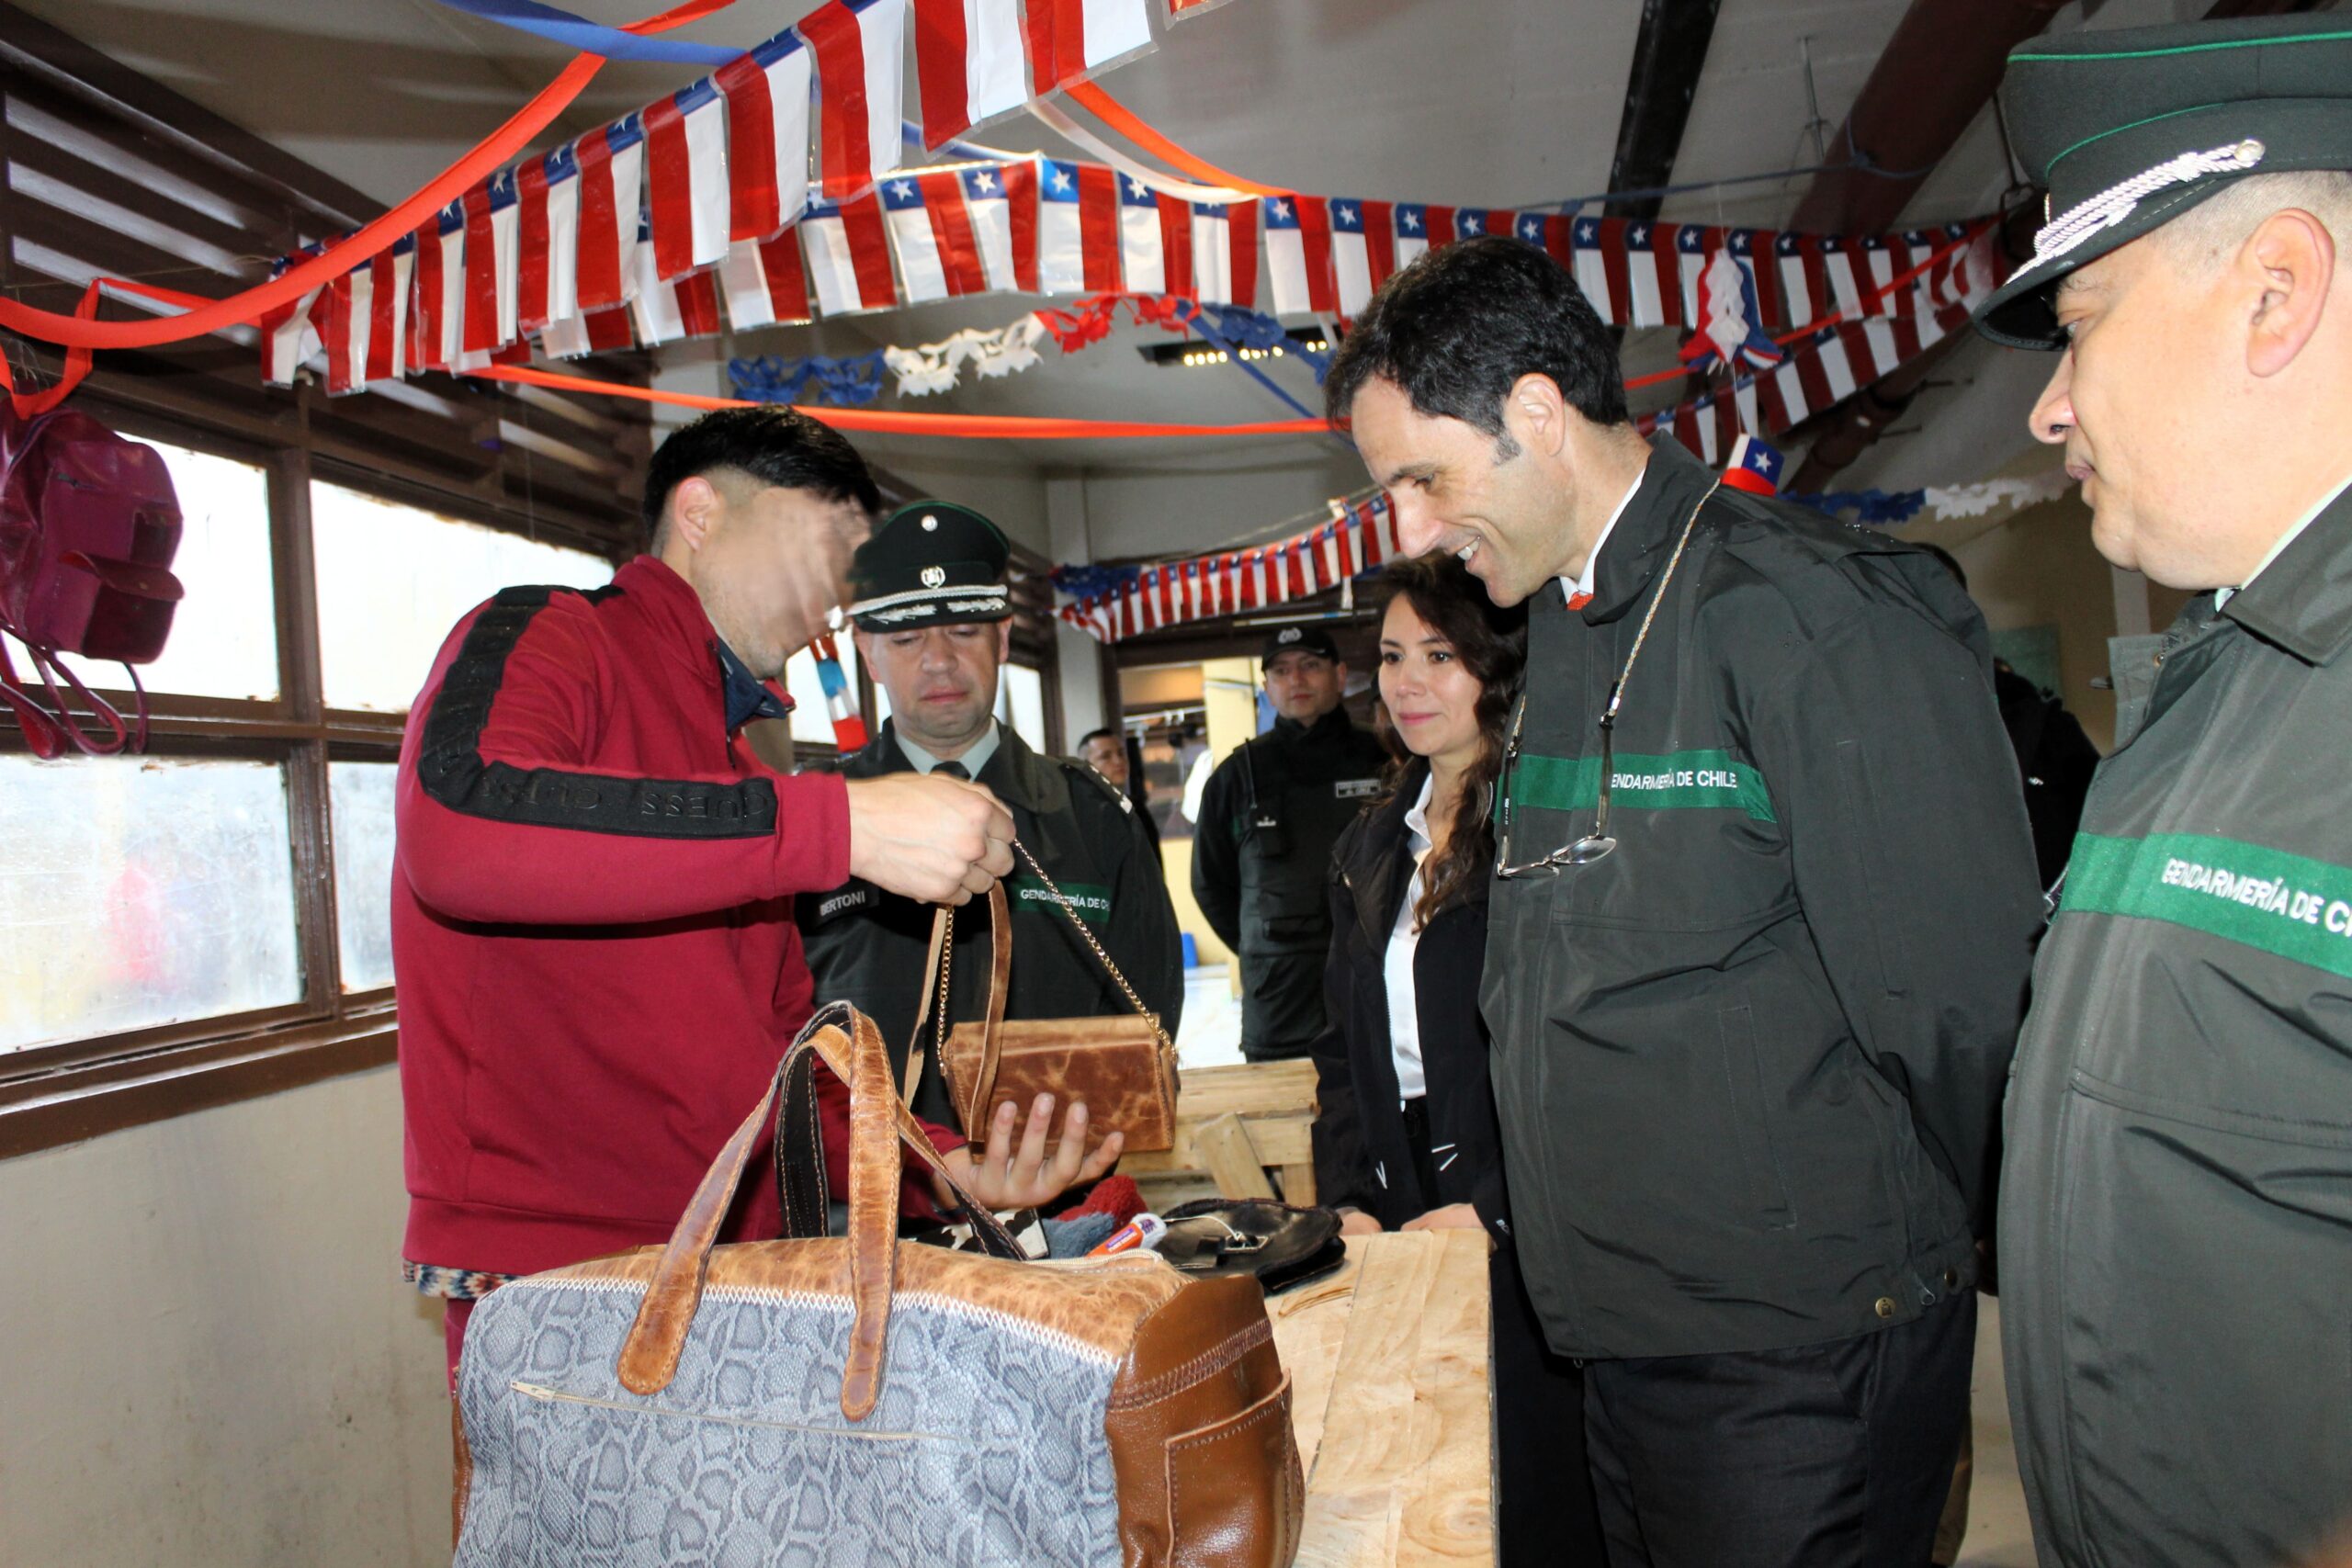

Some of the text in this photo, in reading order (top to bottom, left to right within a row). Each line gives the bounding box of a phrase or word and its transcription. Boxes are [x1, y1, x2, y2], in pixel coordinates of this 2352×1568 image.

[1611, 768, 1737, 790] ENDARMERÍA DE CHILE
[1087, 897, 1101, 908] DE
[2161, 858, 2290, 916] GENDARMERÍA
[2289, 890, 2325, 924] DE
[820, 890, 865, 917] BERTONI
